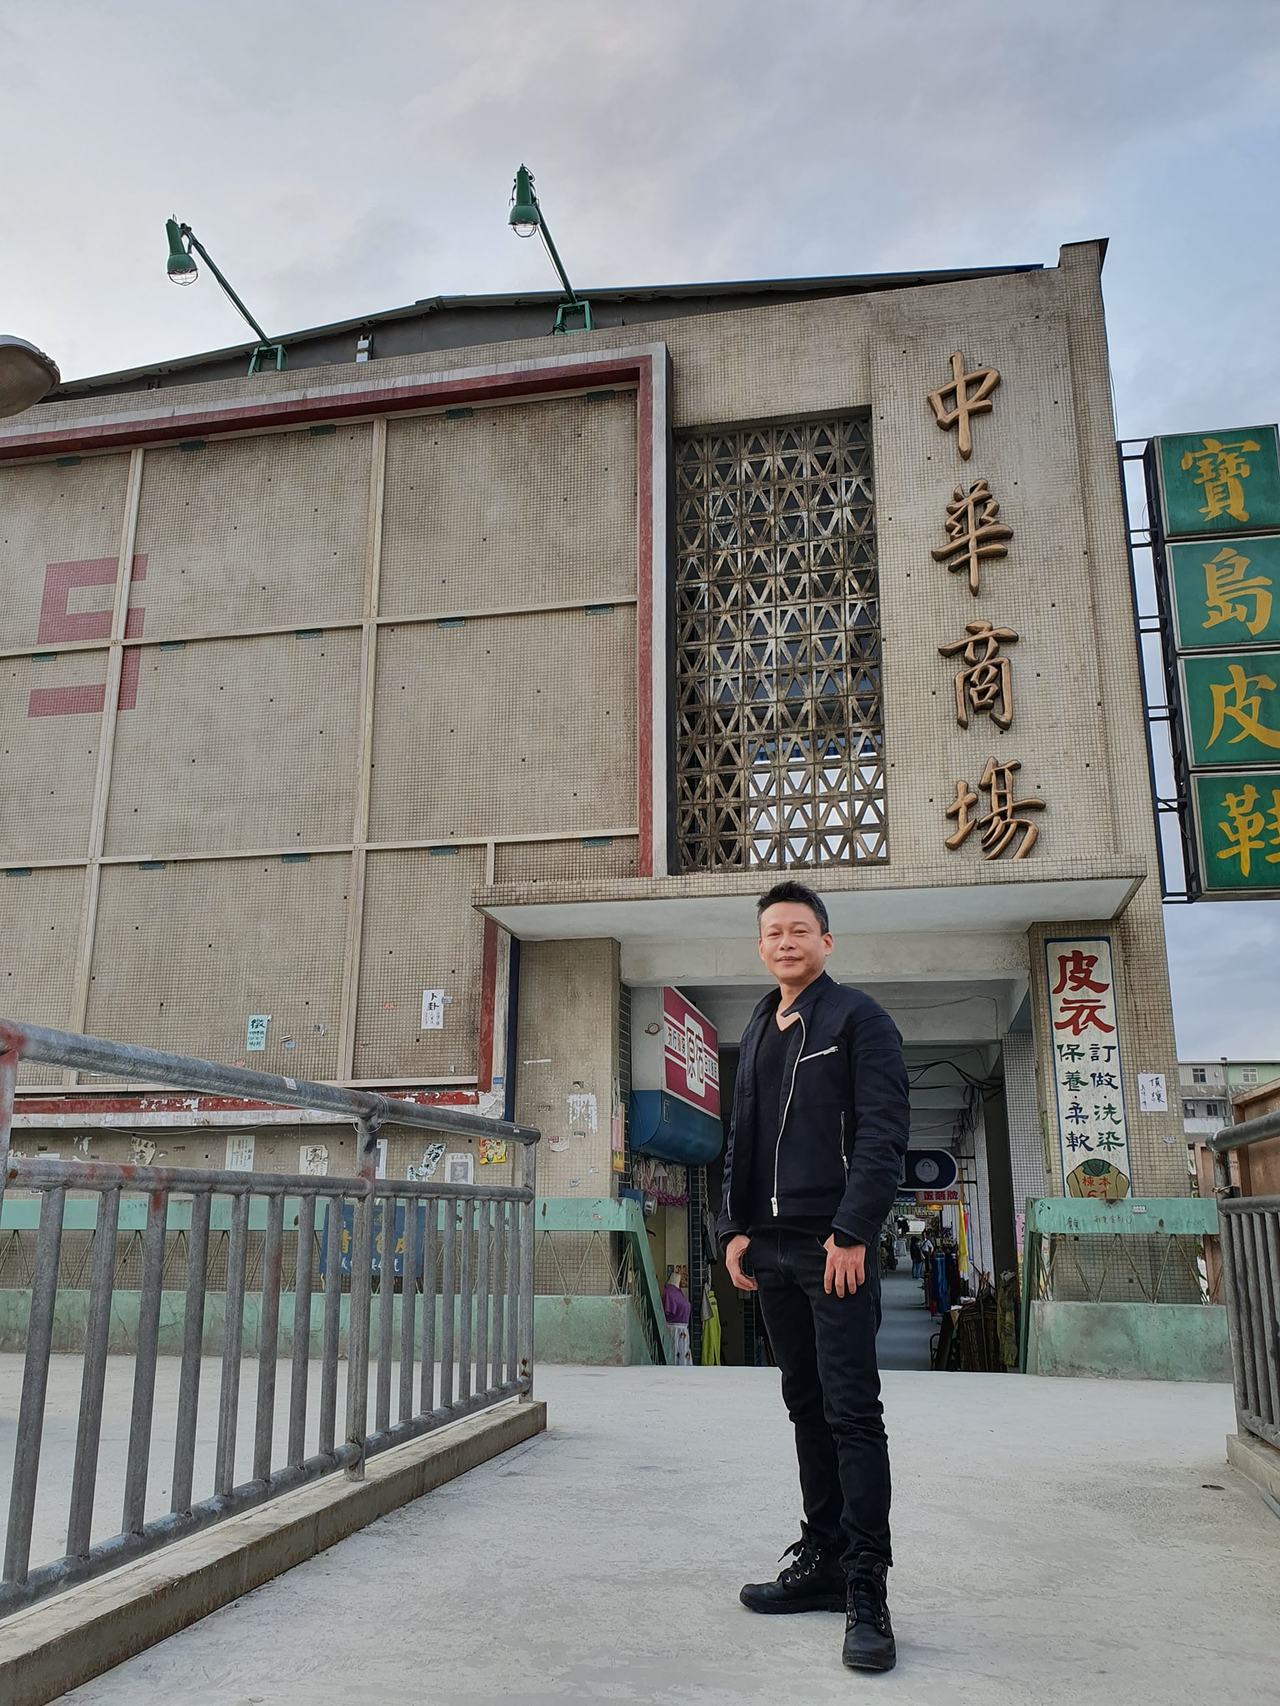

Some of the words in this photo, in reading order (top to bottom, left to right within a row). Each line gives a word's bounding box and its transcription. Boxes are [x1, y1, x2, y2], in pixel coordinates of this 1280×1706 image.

[927, 350, 1045, 860] 中華商場
[1052, 950, 1116, 1036] 皮衣
